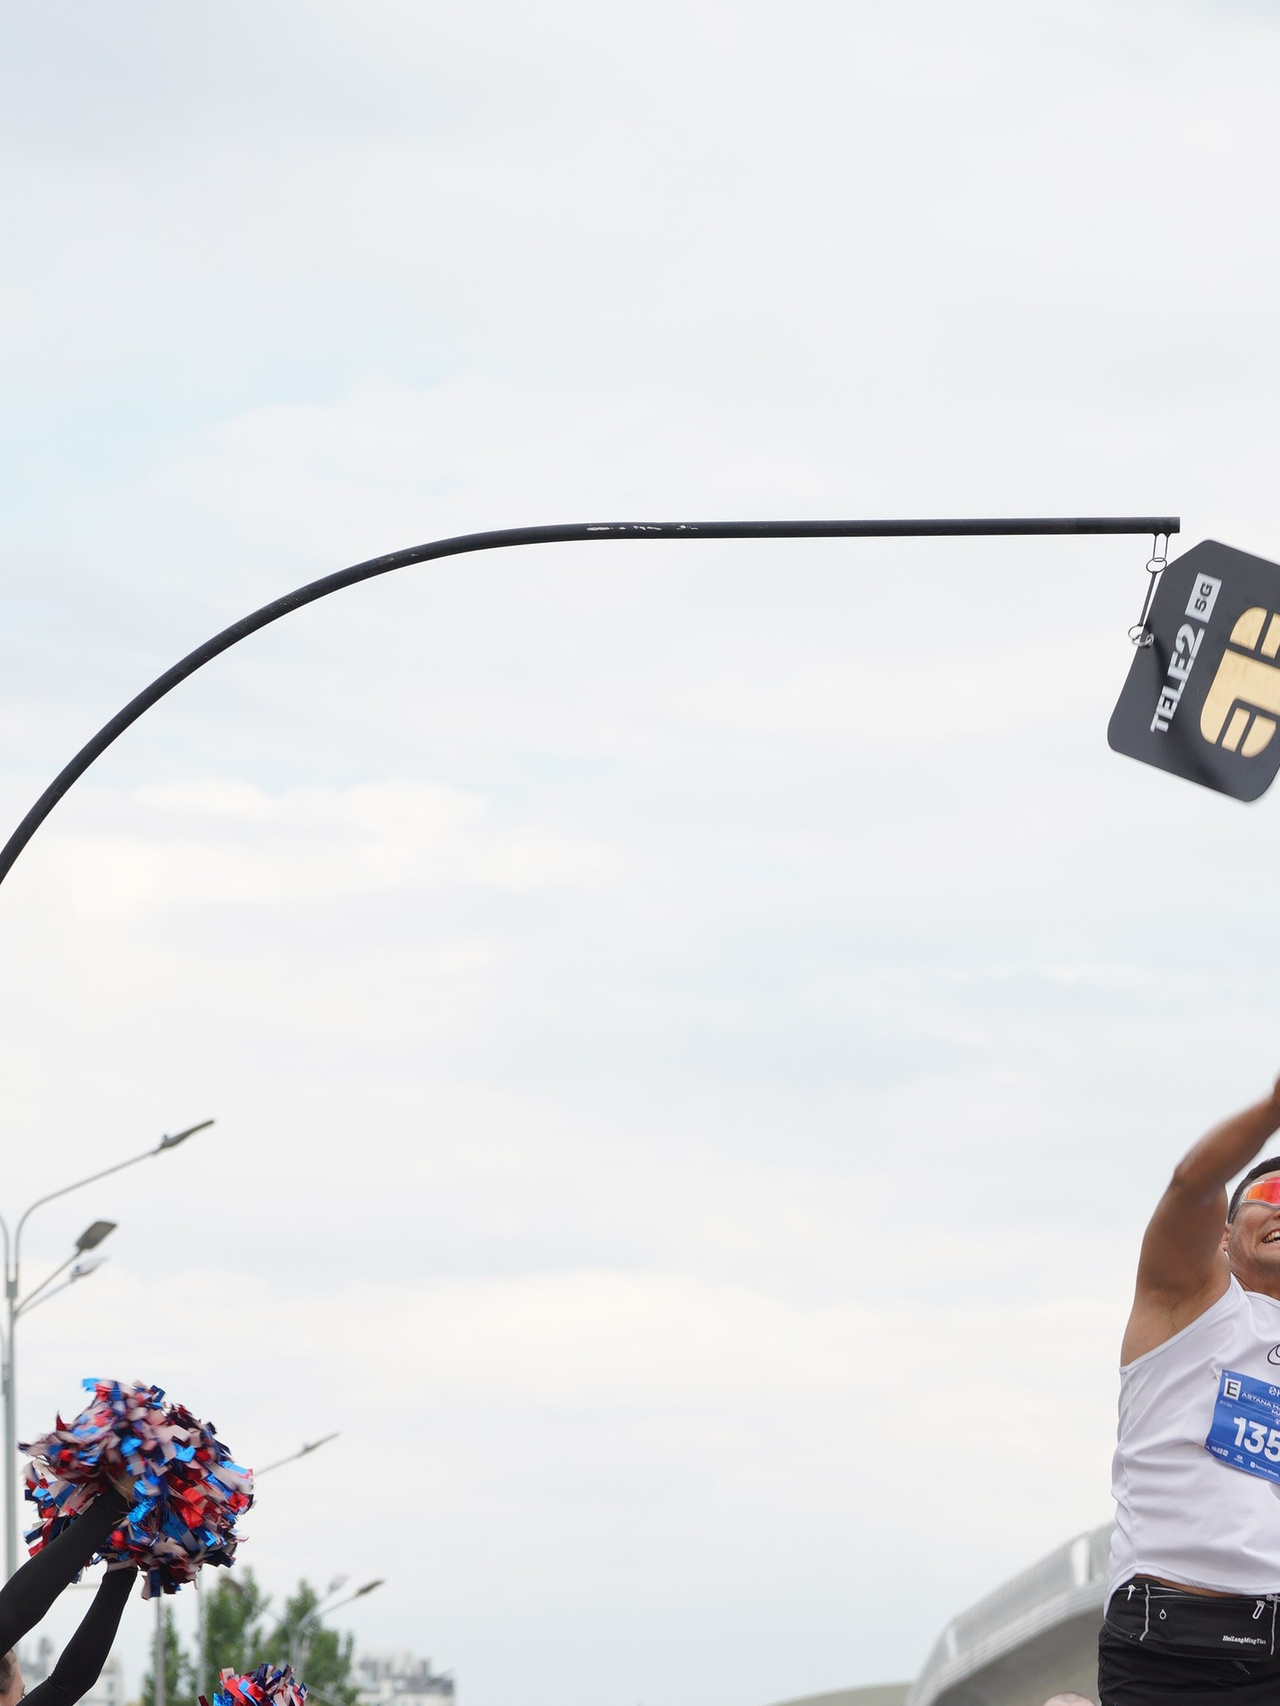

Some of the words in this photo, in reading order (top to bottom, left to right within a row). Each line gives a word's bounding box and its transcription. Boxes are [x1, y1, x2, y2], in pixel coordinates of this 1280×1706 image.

[1150, 623, 1205, 733] TELE2
[1194, 582, 1213, 612] 5G
[1226, 1381, 1239, 1397] E
[1242, 1392, 1272, 1407] ASTANA
